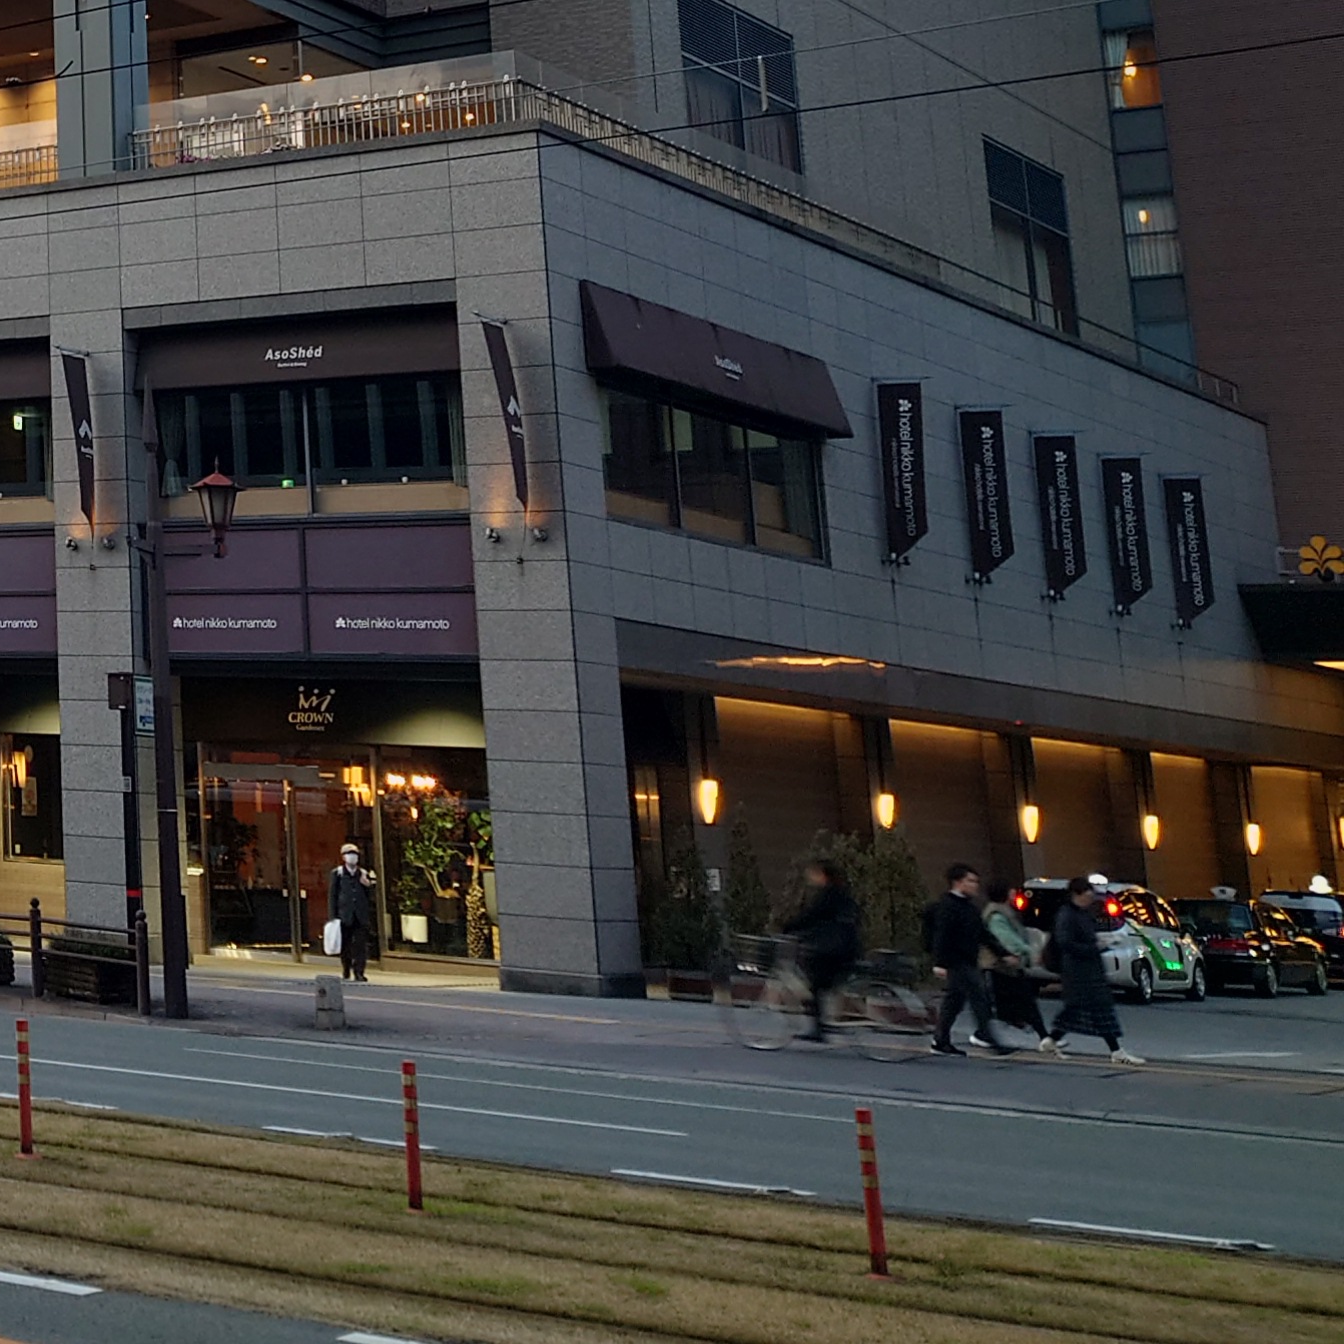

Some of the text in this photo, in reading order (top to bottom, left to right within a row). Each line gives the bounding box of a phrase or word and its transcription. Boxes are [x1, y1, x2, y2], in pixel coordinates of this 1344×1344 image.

[183, 617, 204, 629] hotel
[205, 617, 227, 629] nikko
[346, 617, 450, 630] hotel nikko kumamoto
[288, 712, 334, 723] CROWN
